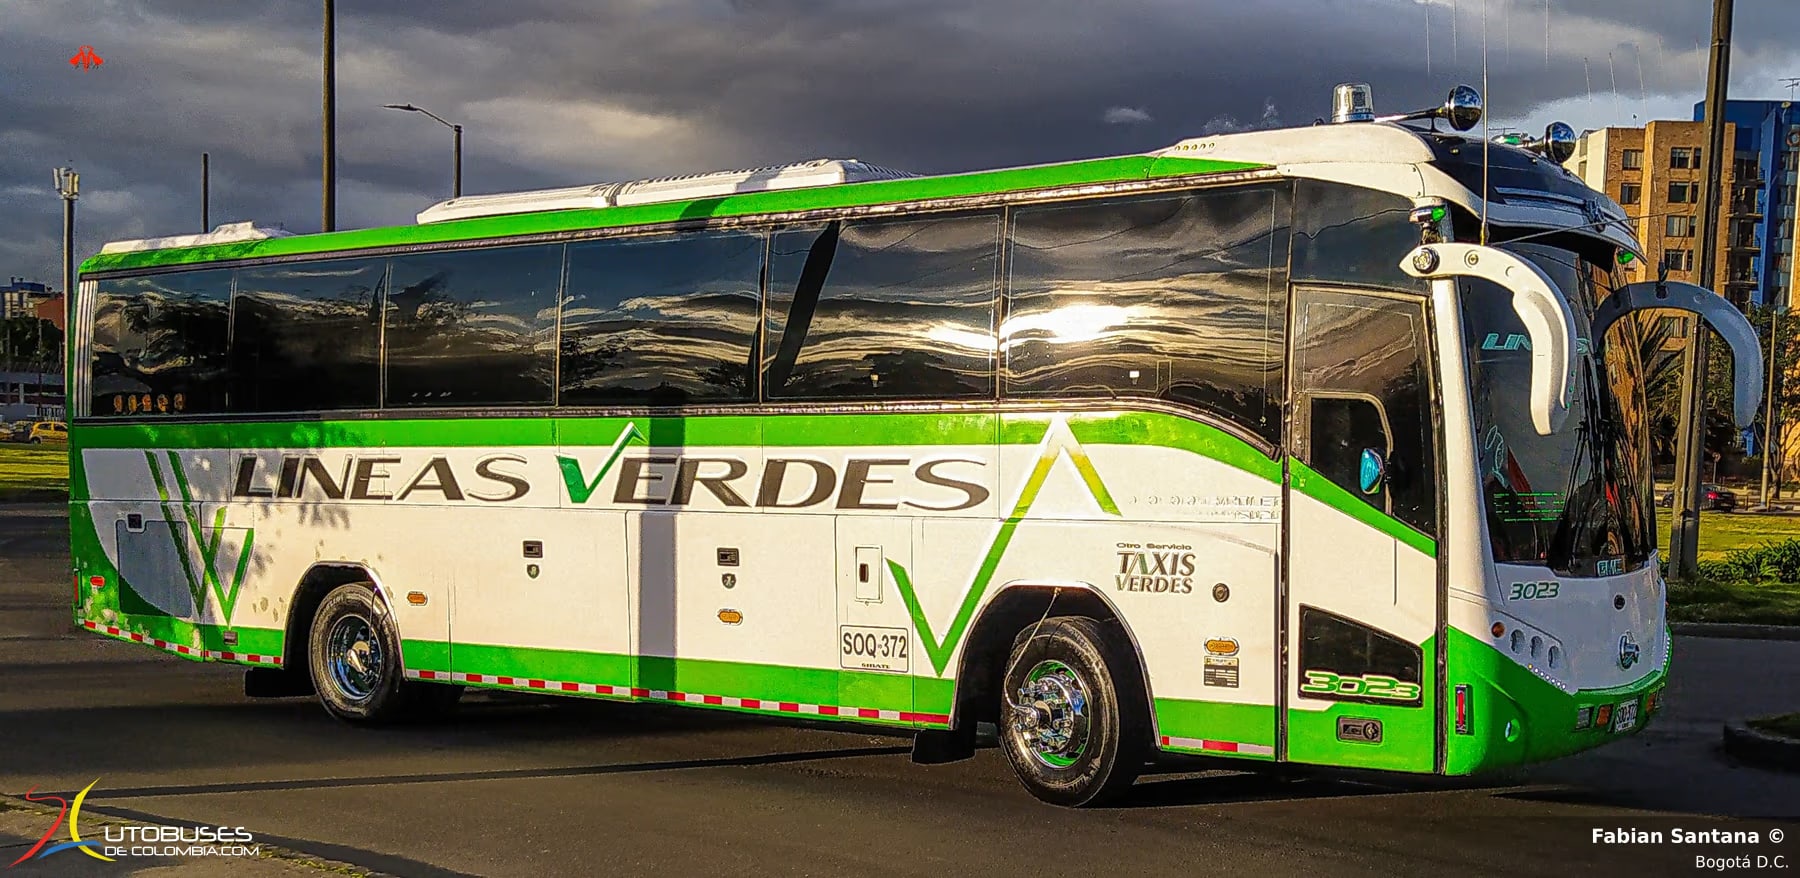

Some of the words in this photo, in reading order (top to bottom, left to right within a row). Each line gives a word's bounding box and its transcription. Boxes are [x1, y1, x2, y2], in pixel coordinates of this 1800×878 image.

[232, 453, 530, 501] LINEAS
[555, 421, 990, 511] VERDES
[1117, 551, 1196, 577] TAXIS
[1115, 575, 1194, 594] VERDES
[1509, 582, 1560, 600] 3023
[1300, 670, 1421, 700] 3023
